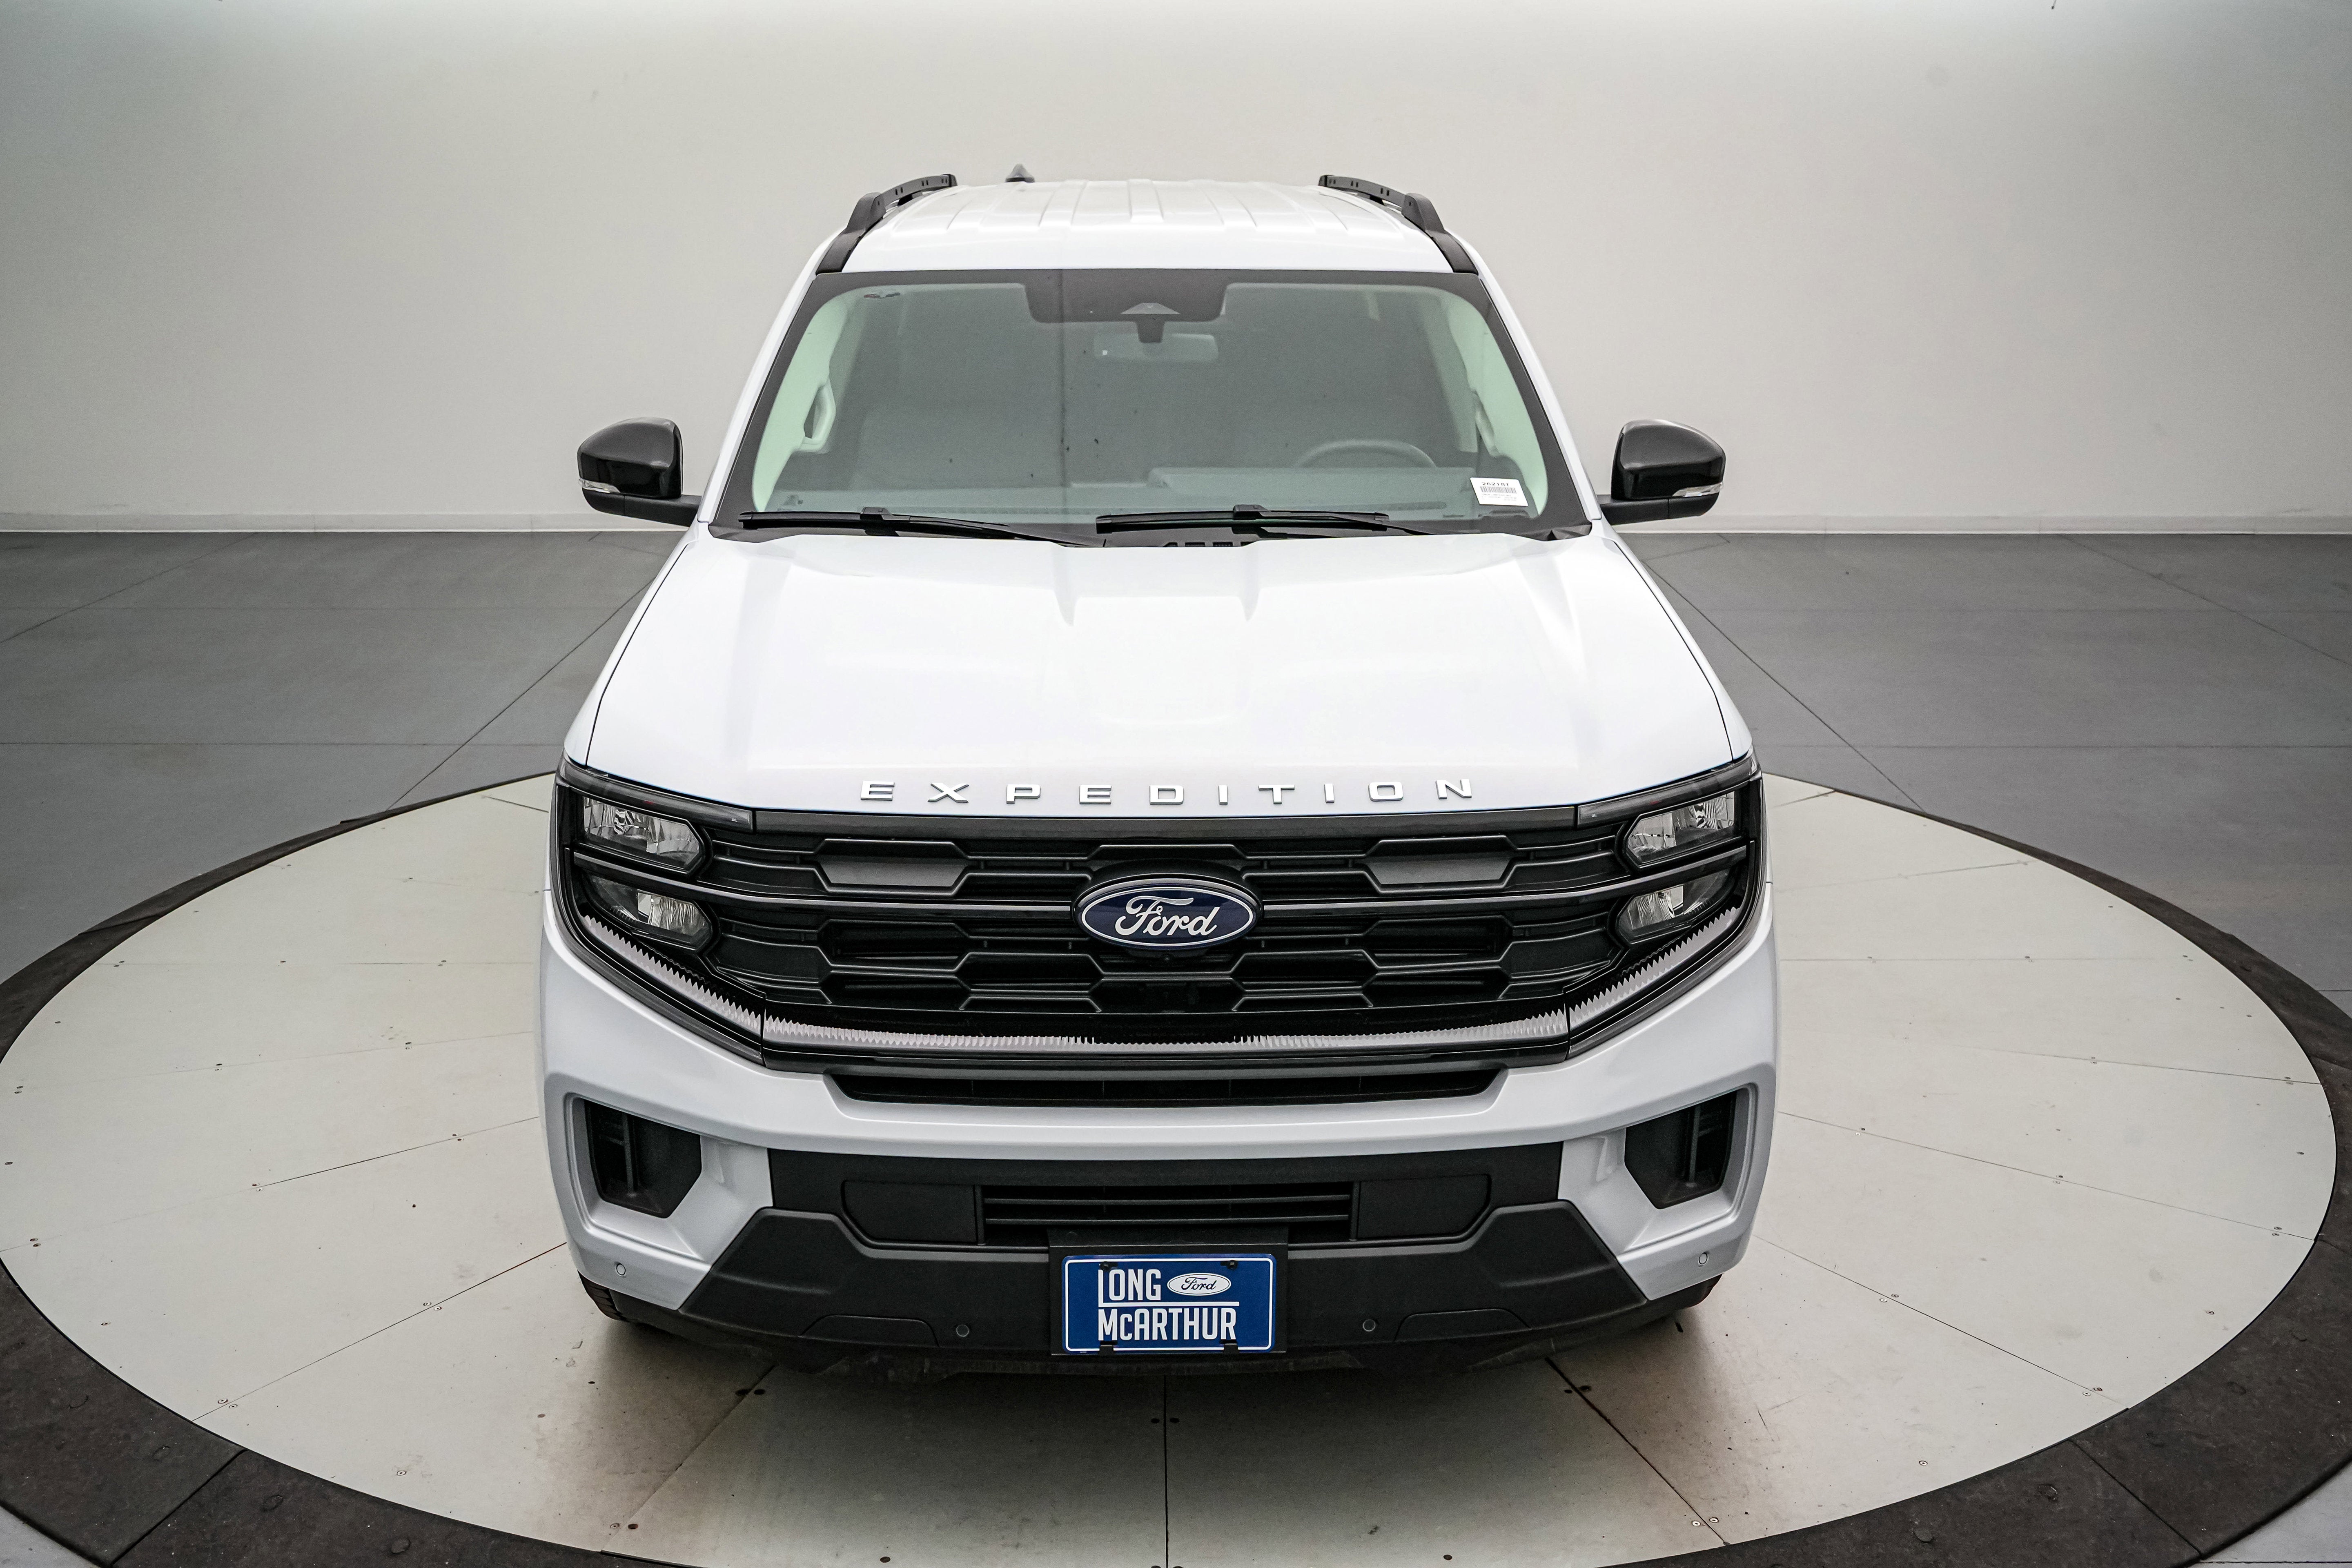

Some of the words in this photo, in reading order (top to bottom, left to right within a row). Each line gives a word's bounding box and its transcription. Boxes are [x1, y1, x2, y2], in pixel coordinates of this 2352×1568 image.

[860, 779, 1472, 805] EXPEDITION
[1115, 895, 1220, 935] Ford
[1098, 1269, 1161, 1307] LONG
[1181, 1277, 1217, 1291] Ford
[1098, 1308, 1236, 1341] McARTHUR
